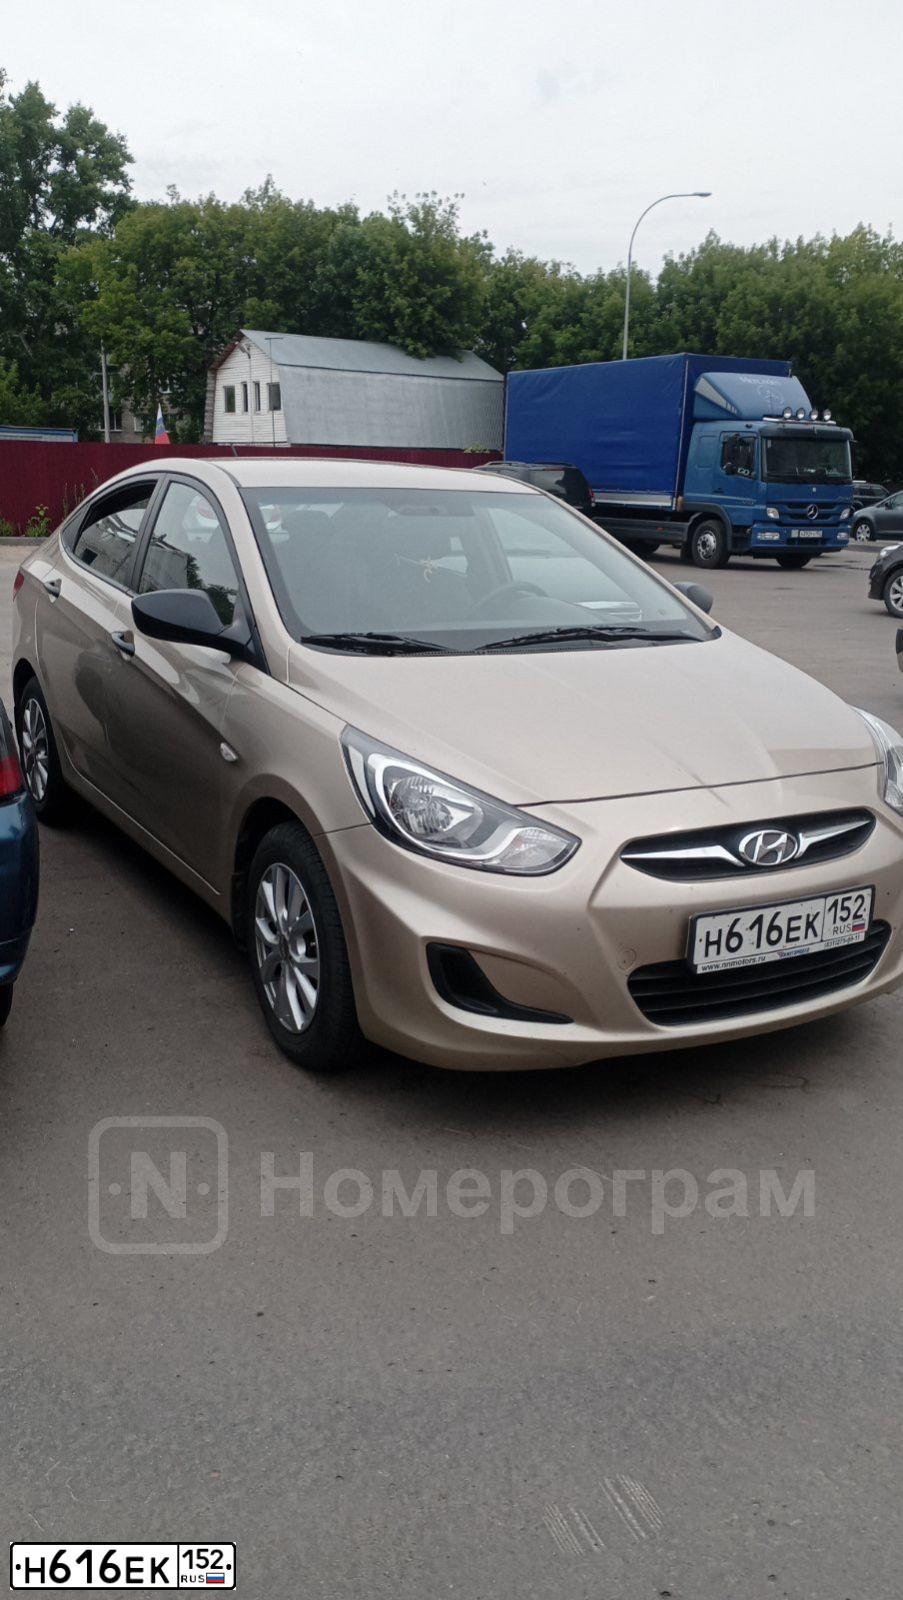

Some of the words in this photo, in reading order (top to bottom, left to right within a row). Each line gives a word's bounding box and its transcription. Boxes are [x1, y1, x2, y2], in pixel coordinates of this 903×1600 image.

[704, 911, 820, 957] Н616ЕК
[827, 893, 866, 924] 152
[832, 924, 852, 935] RUS
